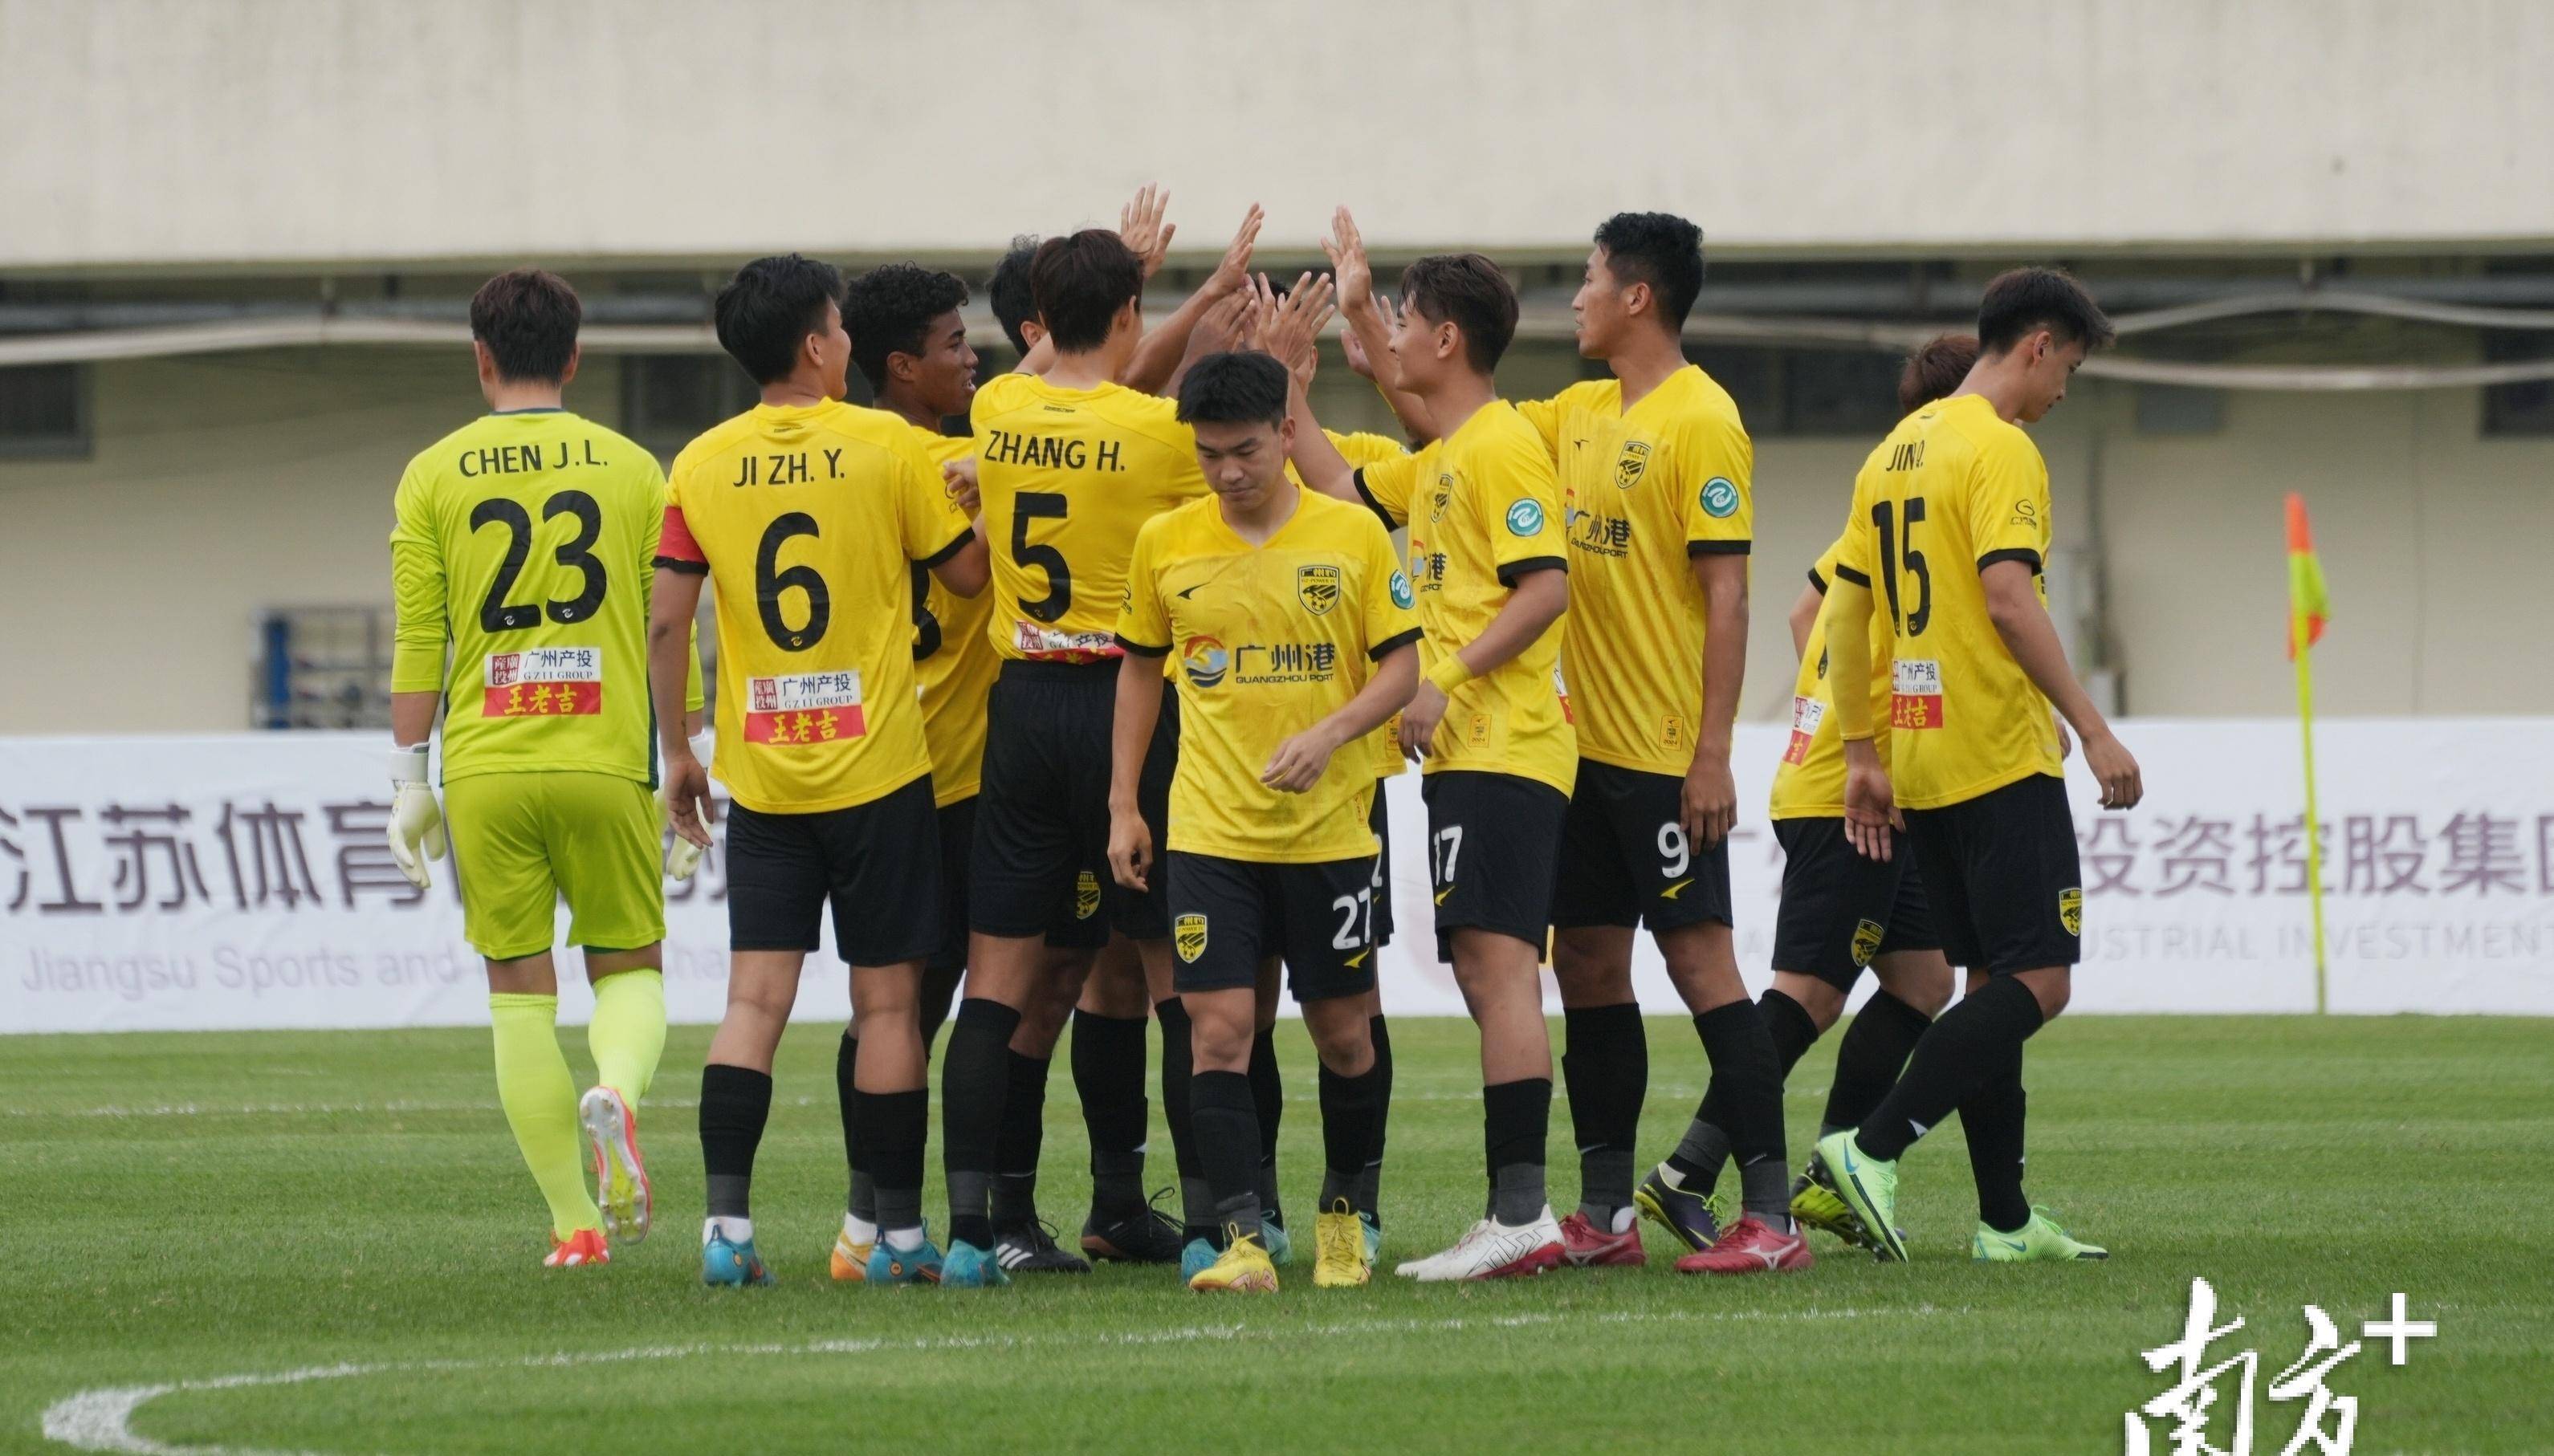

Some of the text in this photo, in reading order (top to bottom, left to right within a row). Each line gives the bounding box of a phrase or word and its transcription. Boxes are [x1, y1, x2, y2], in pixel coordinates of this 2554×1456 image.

[459, 444, 542, 478] CHEN
[733, 448, 845, 487] JI ZH. Y.
[984, 429, 1126, 472] ZHANG H.
[1886, 443, 1917, 472] JIN
[1573, 510, 1630, 548] 广州港
[470, 490, 607, 633] 23
[1012, 491, 1071, 624] 5
[1872, 497, 1931, 638] 15
[756, 512, 830, 653] 6
[524, 649, 593, 669] 广州产投
[557, 670, 593, 680] GROUP
[1236, 643, 1335, 673] 广州港
[1901, 662, 1937, 681] 广州产投
[783, 673, 851, 697] 广州产投
[1236, 673, 1334, 684] GUANGZHOU PORT
[504, 683, 577, 715] 王老吉
[816, 695, 853, 707] GROUP
[768, 710, 839, 744] 王老吉
[1434, 825, 1463, 887] 17
[1658, 821, 1689, 879] 9
[2076, 812, 2554, 898] 投资控股集
[1332, 887, 1371, 950] 27
[2080, 923, 2259, 962] USTRIAL
[21, 945, 198, 1002] Jiangsu
[212, 938, 360, 999] Sports
